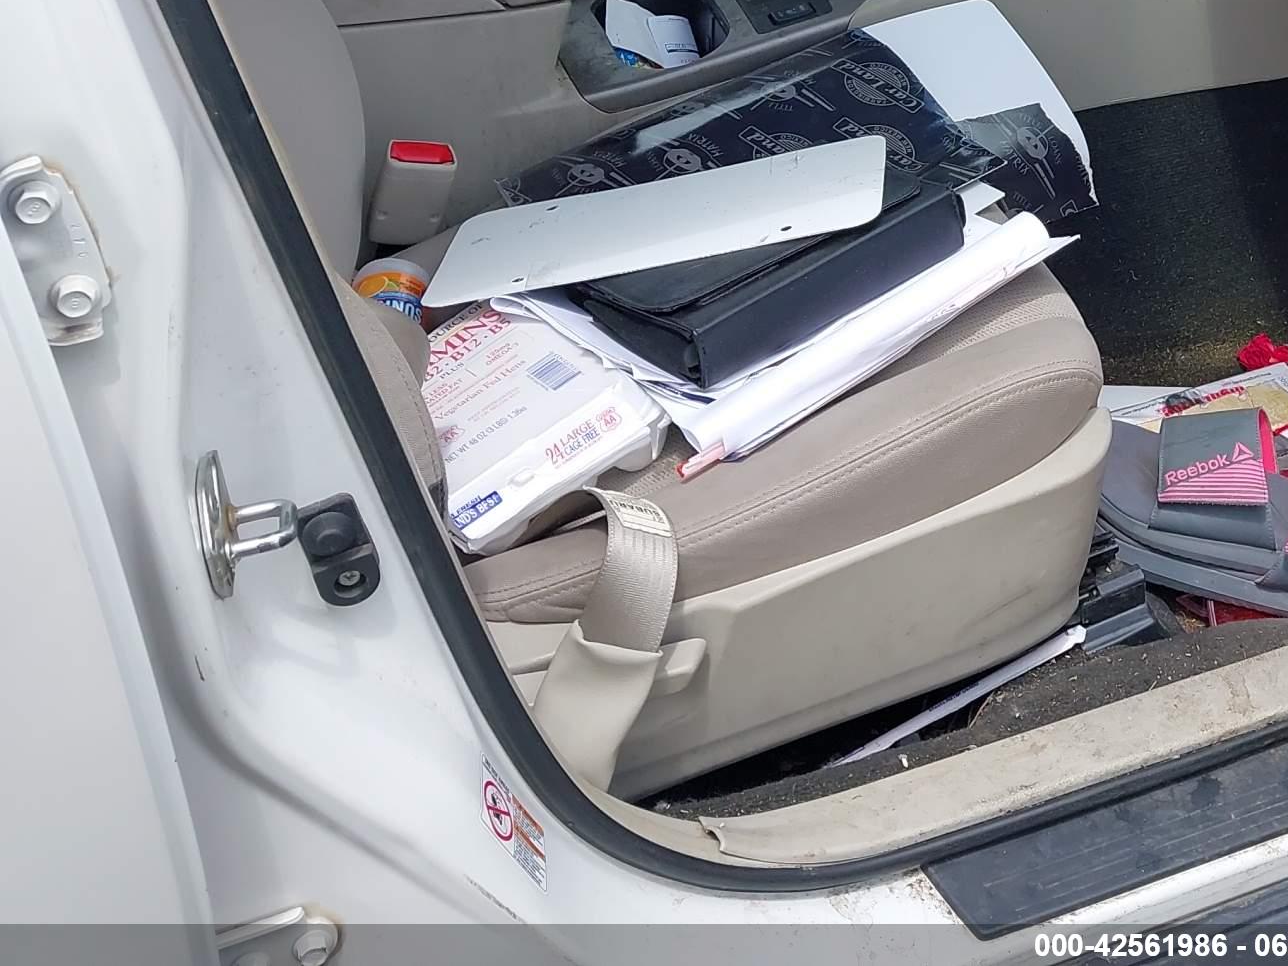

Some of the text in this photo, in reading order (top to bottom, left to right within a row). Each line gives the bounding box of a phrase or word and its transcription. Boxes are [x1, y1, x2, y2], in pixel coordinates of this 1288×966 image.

[839, 62, 886, 89] Land
[885, 87, 918, 108] Car
[451, 338, 482, 362] B12
[488, 317, 512, 335] B5
[439, 361, 465, 379] PLUS
[434, 388, 484, 421] Vegetarian
[560, 419, 596, 447] LARGE
[564, 428, 601, 456] CAGE FREE
[545, 439, 565, 466] 24
[1164, 453, 1231, 486] Reebok
[608, 498, 661, 518] SUBARU
